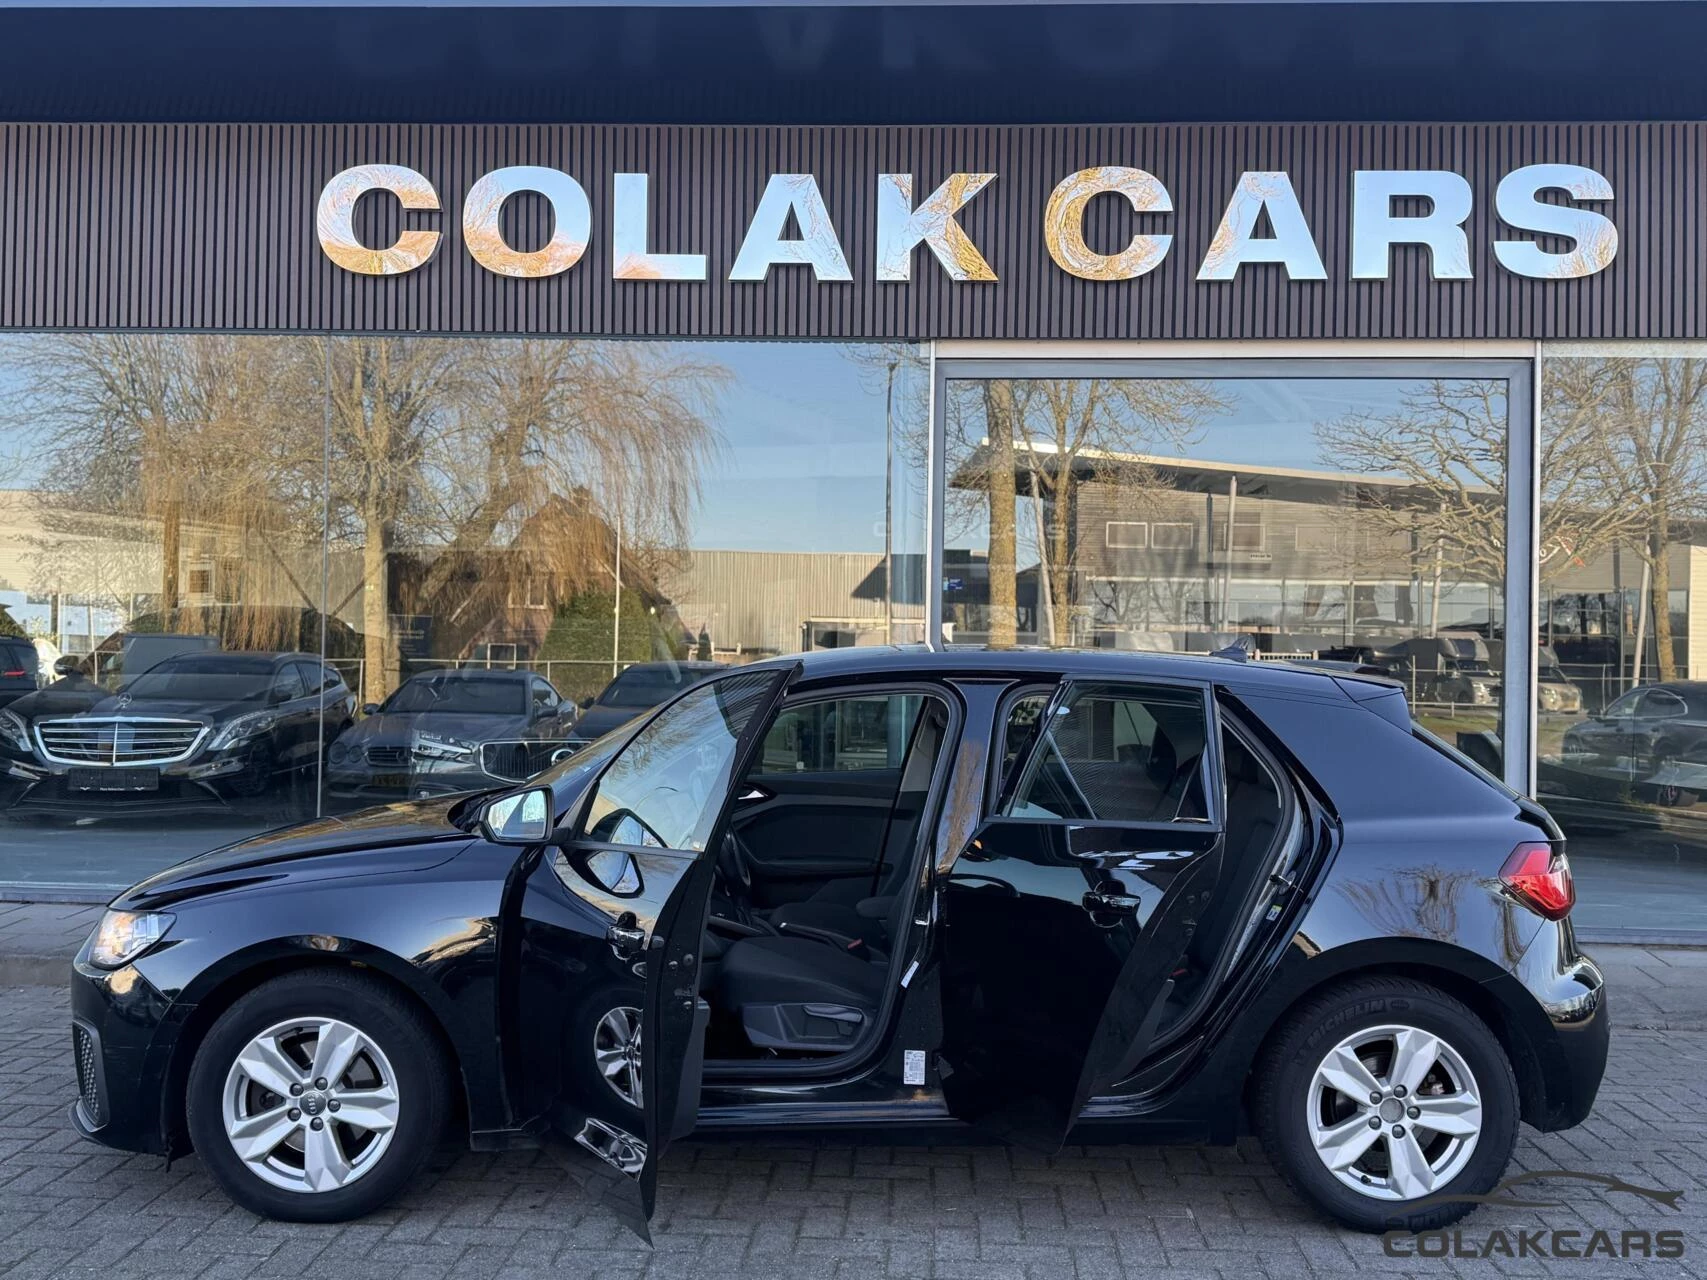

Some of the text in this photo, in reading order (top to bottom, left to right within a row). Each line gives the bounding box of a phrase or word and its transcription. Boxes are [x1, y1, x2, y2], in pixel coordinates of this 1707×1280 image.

[316, 163, 1619, 282] COLAK CARS
[1307, 999, 1385, 1048] MICHELIN
